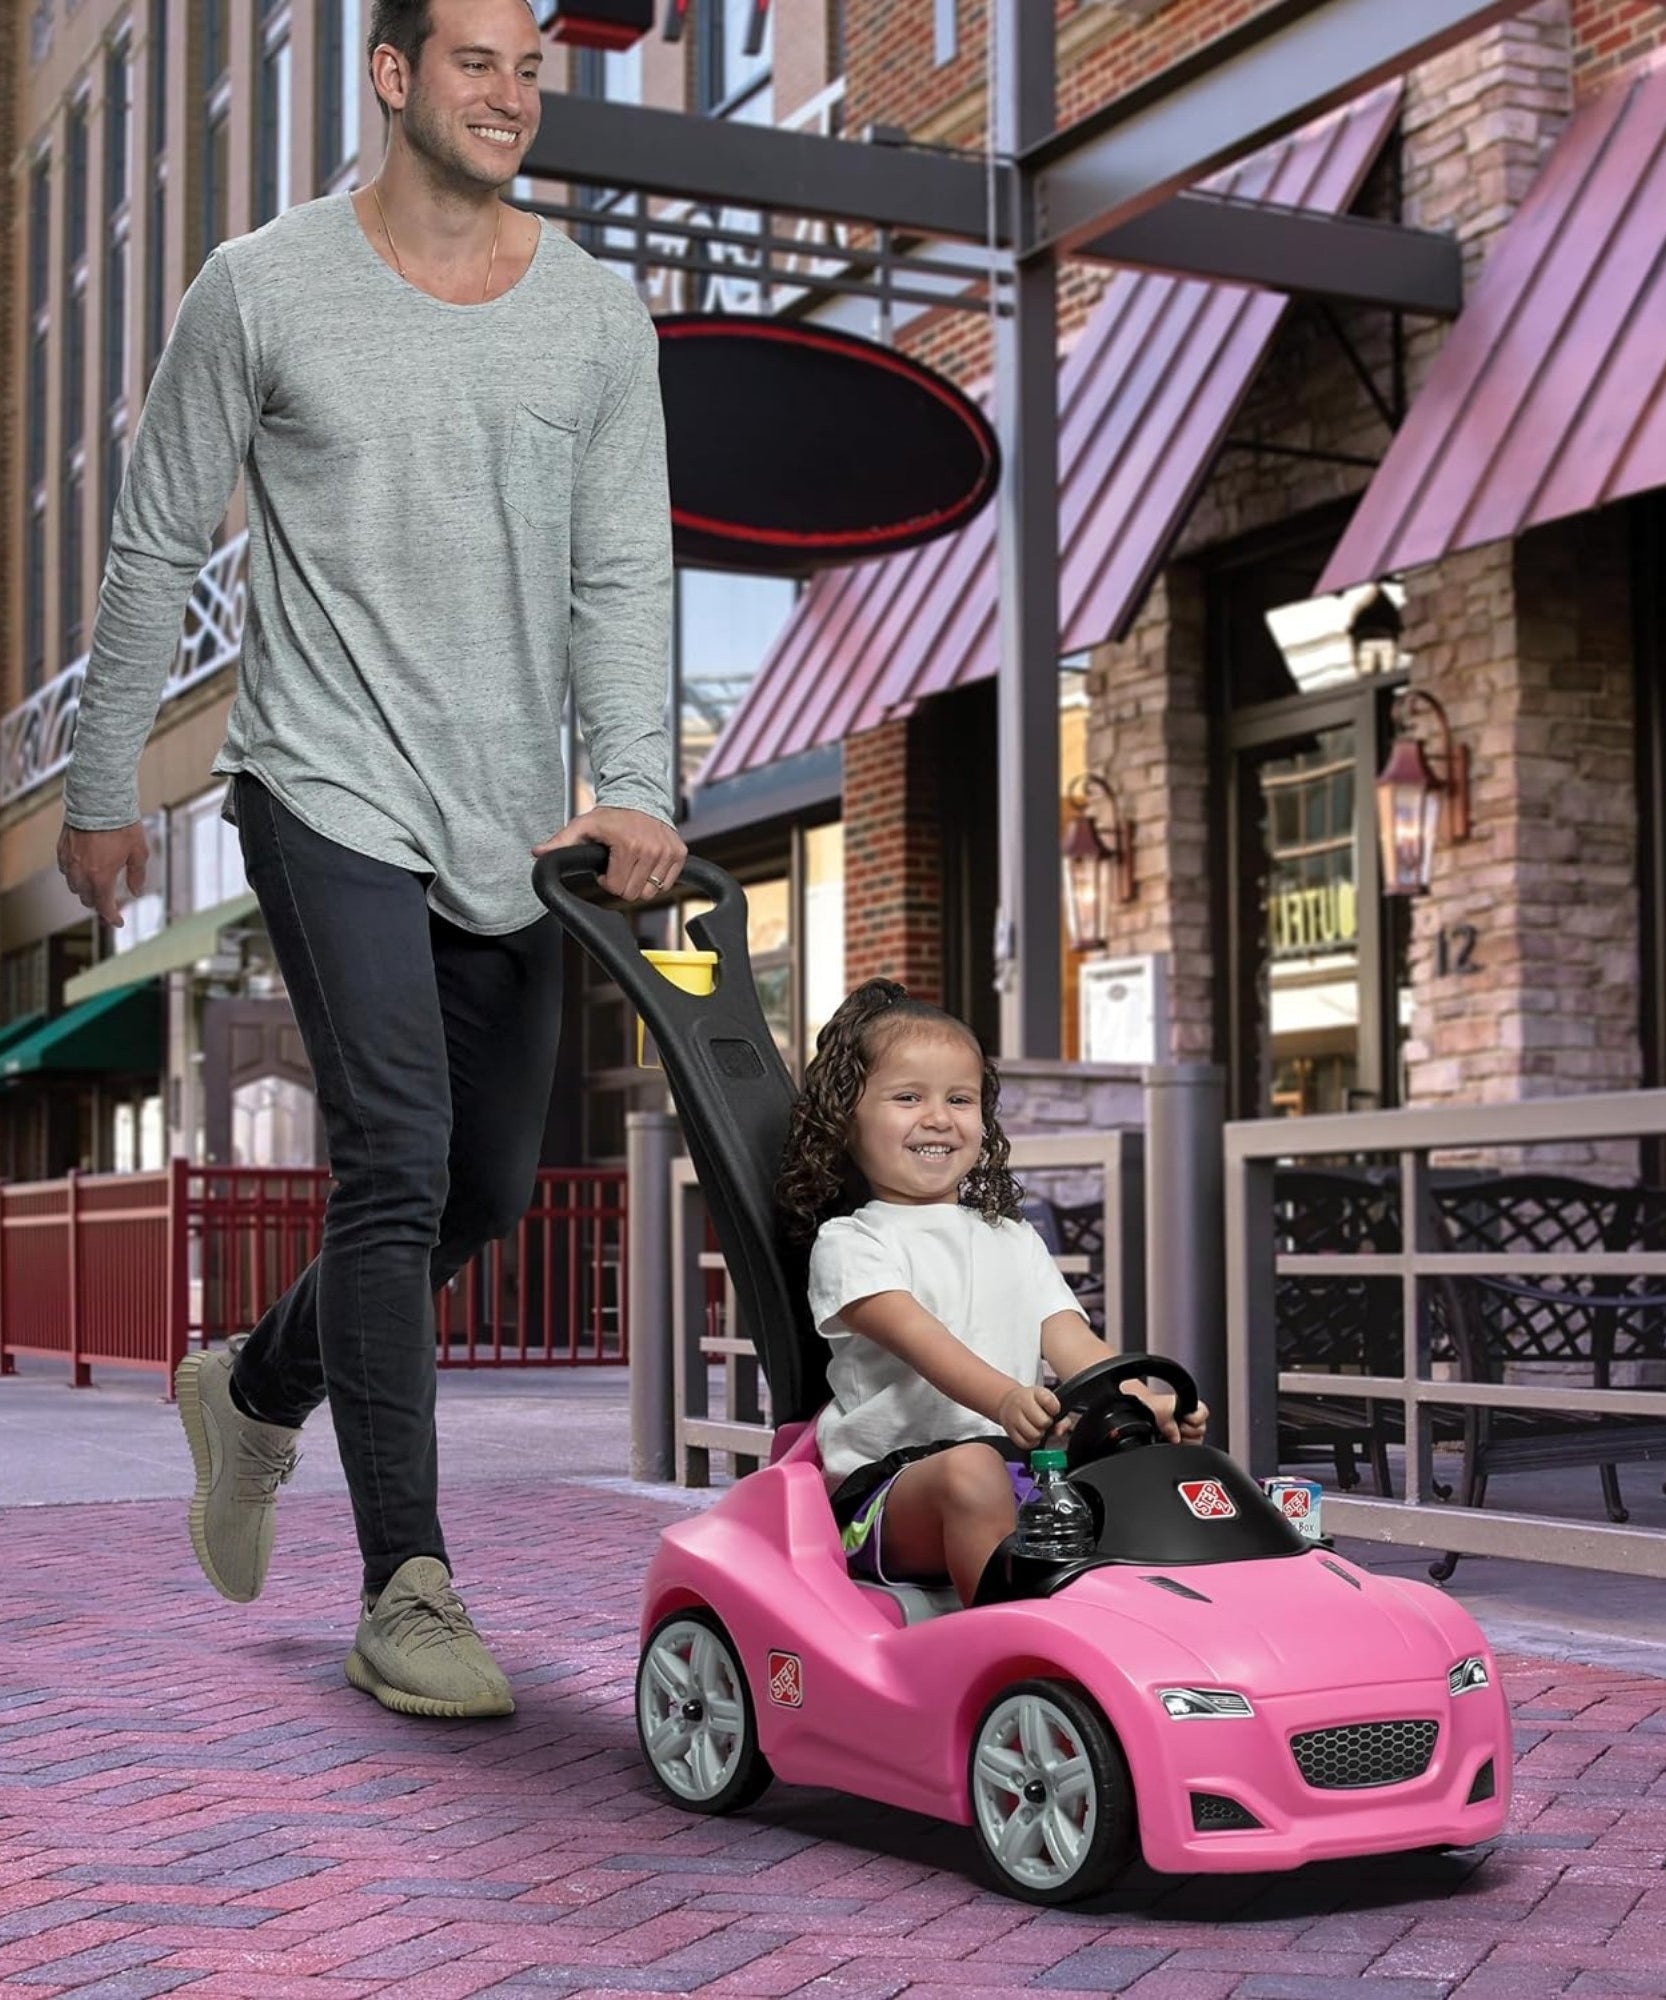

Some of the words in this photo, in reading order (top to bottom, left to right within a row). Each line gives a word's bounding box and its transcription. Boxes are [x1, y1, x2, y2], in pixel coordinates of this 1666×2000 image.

[1436, 924, 1484, 977] 12
[1194, 1484, 1218, 1514] STEP
[1214, 1500, 1230, 1514] 2
[1283, 1490, 1306, 1516] STEP
[771, 1660, 796, 1699] STEP
